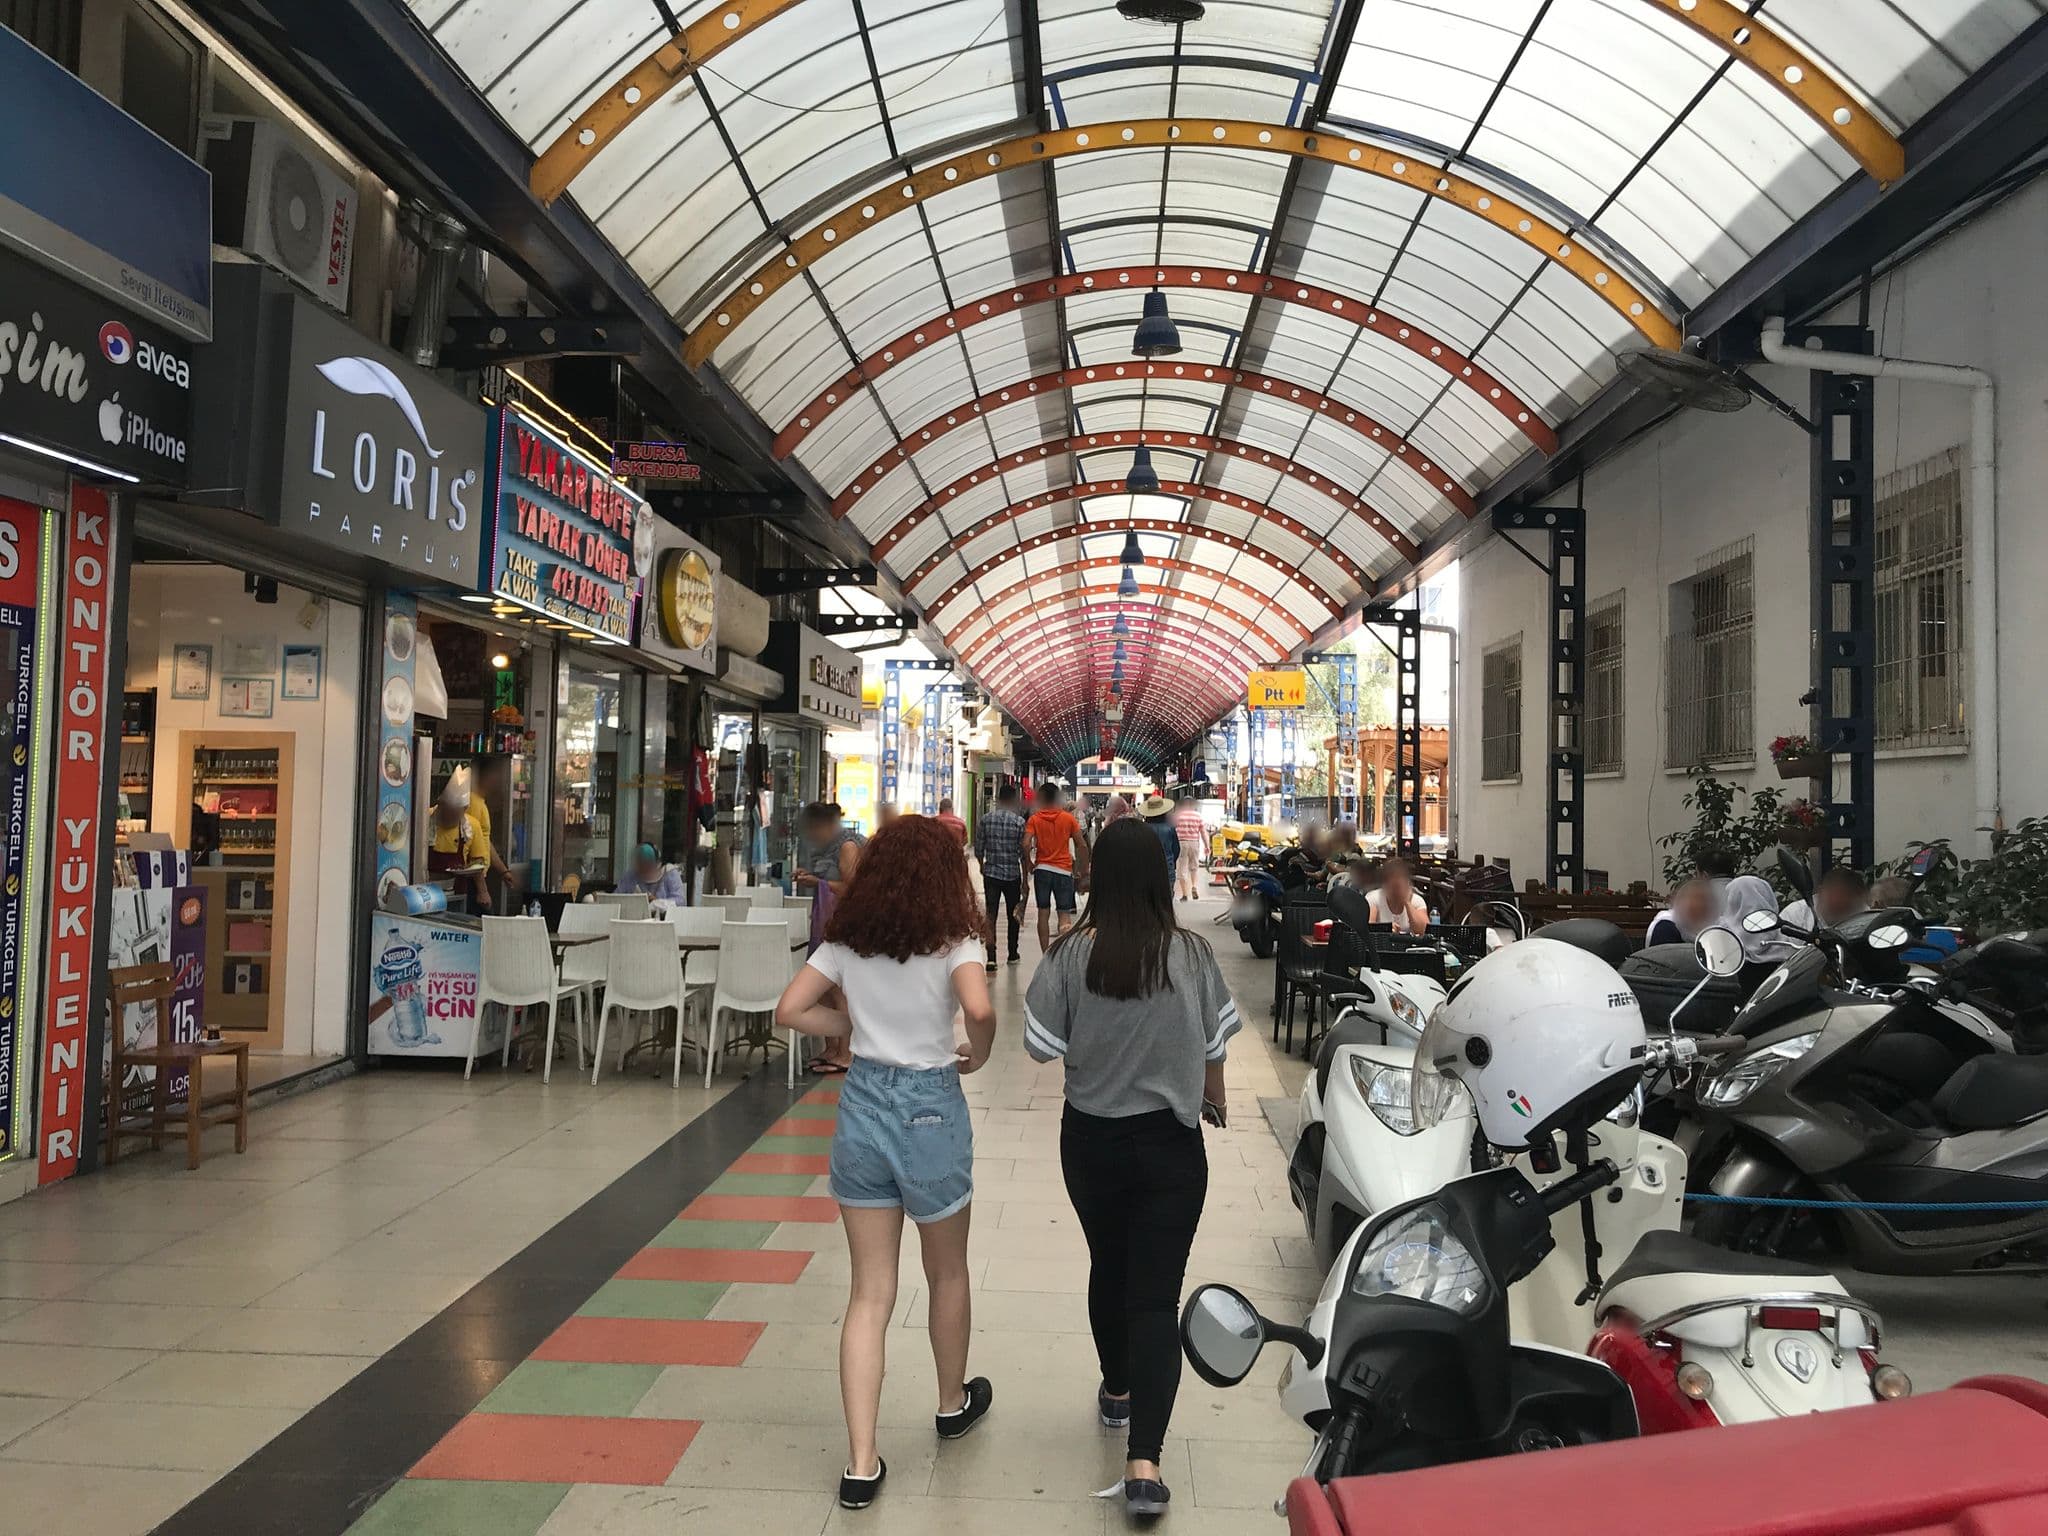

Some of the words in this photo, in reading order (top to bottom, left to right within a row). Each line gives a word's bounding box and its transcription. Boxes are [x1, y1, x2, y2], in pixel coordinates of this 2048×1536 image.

[327, 198, 348, 286] VESTEL
[120, 268, 152, 301] Sevgi
[136, 341, 190, 389] avea
[126, 410, 187, 464] iPhone
[628, 444, 688, 463] BURSA
[516, 426, 589, 514] YAKAR
[614, 456, 701, 480] İSKENDER
[309, 502, 460, 573] PARFUM
[516, 495, 583, 563] YAPRAK
[507, 547, 538, 581] TAKE
[511, 574, 539, 603] WAY
[608, 595, 629, 619] TAKE
[68, 511, 104, 762] KONTÖR
[610, 616, 630, 638] WAY
[16, 643, 31, 735] TURKCELL
[1265, 687, 1285, 701] Ptt
[9, 774, 25, 867] TURKCELL
[2, 899, 17, 994] TURKCELL
[430, 931, 470, 943] WATER
[381, 971, 403, 985] Pure
[404, 963, 422, 978] Life
[427, 979, 449, 995] İYİ
[452, 980, 477, 996] SU
[47, 818, 91, 1165] YÜKLENİR
[427, 995, 476, 1021] İÇİN
